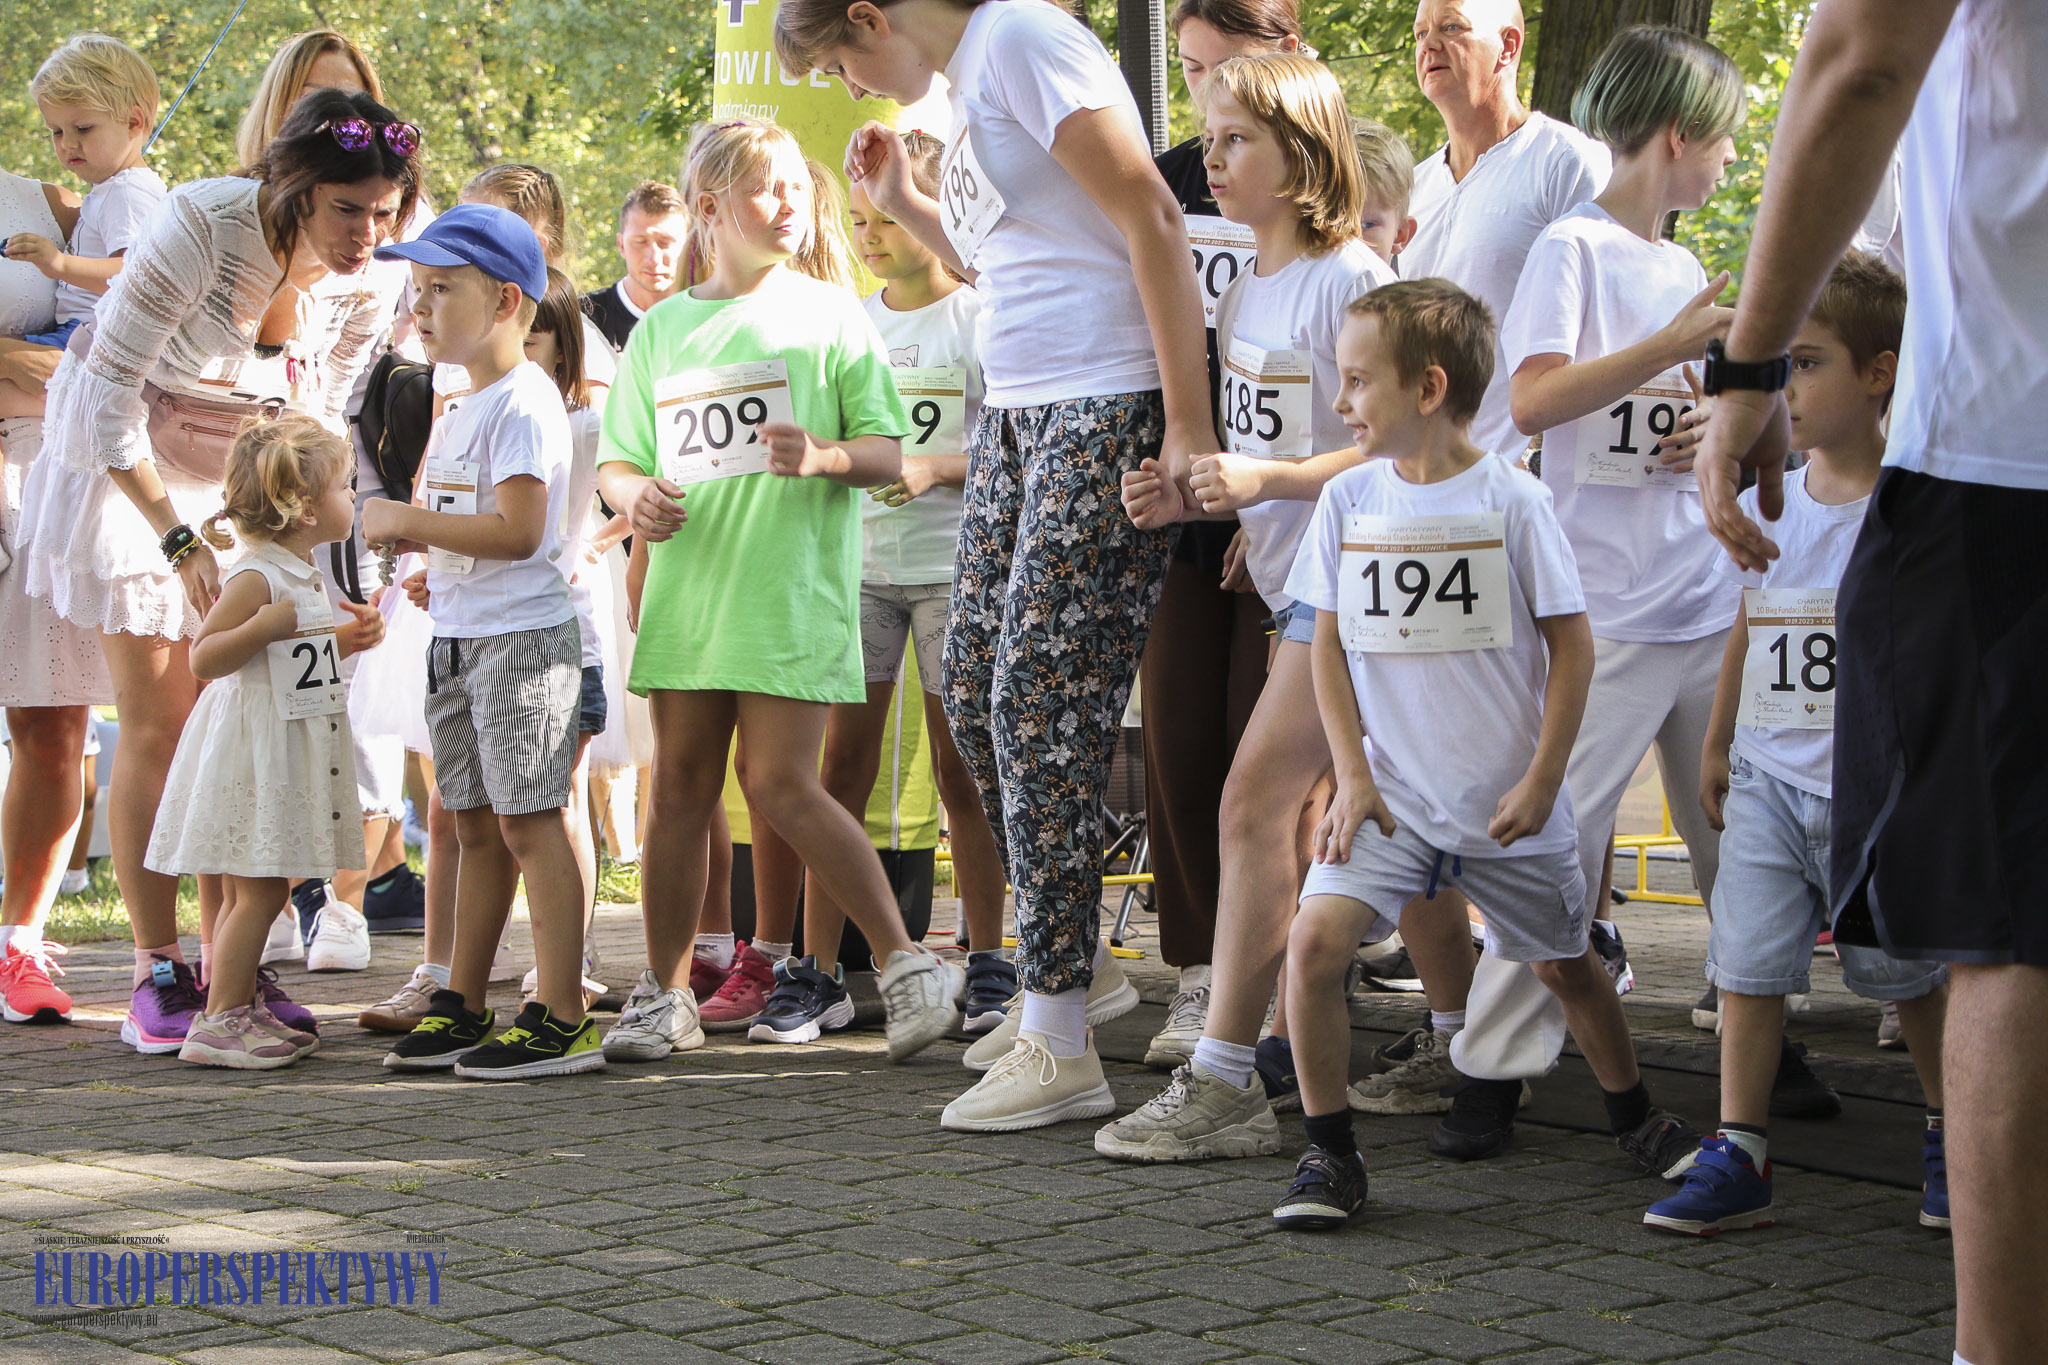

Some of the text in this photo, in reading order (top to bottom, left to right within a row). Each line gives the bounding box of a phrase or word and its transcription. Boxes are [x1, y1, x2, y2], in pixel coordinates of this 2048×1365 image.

[944, 149, 979, 231] 196
[673, 396, 768, 457] 209
[911, 400, 942, 445] 9
[1225, 376, 1283, 442] 185
[1411, 544, 1448, 552] KATOWICE
[1361, 557, 1479, 617] 194
[1756, 605, 1830, 616] 10 Bieg Fundacji Śląskie
